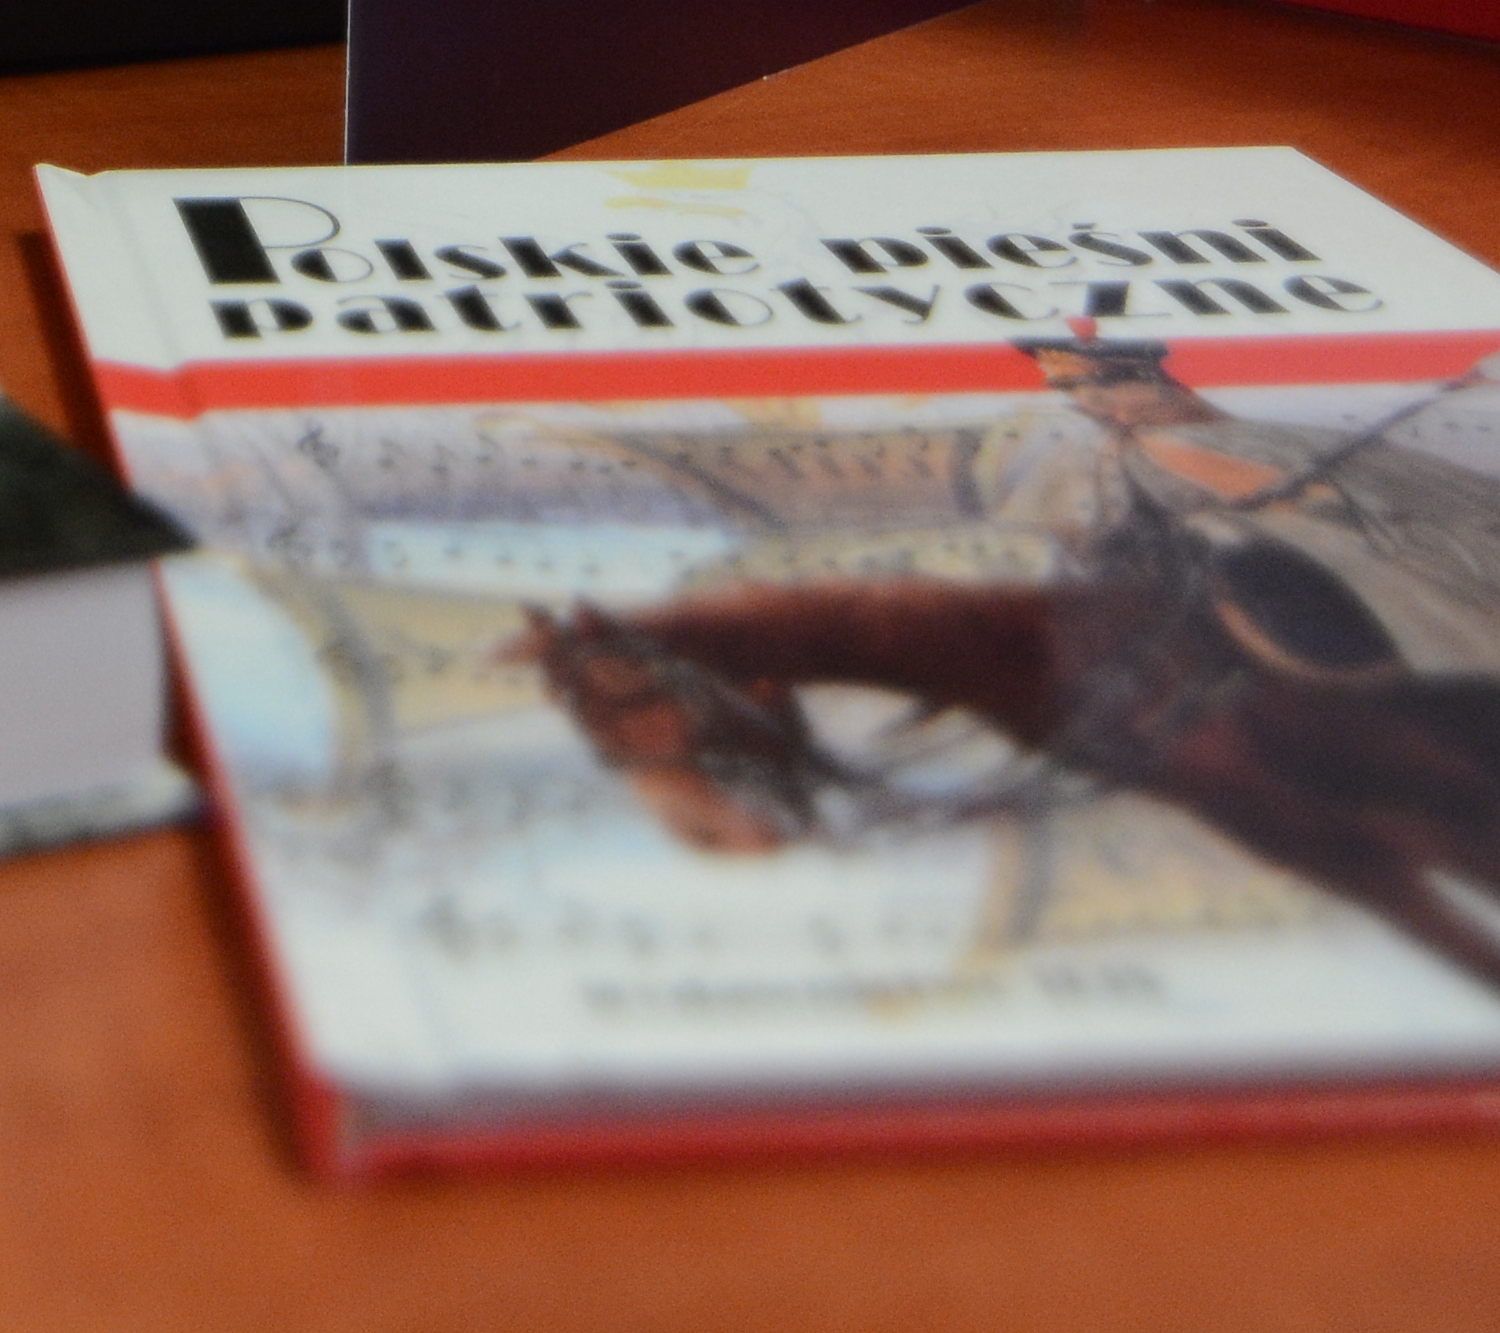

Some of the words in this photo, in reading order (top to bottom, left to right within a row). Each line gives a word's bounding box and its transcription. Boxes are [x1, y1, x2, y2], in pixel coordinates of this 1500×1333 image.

[172, 195, 762, 289] Polskie
[817, 217, 1324, 276] pieśni
[207, 263, 1388, 343] patriotyczne
